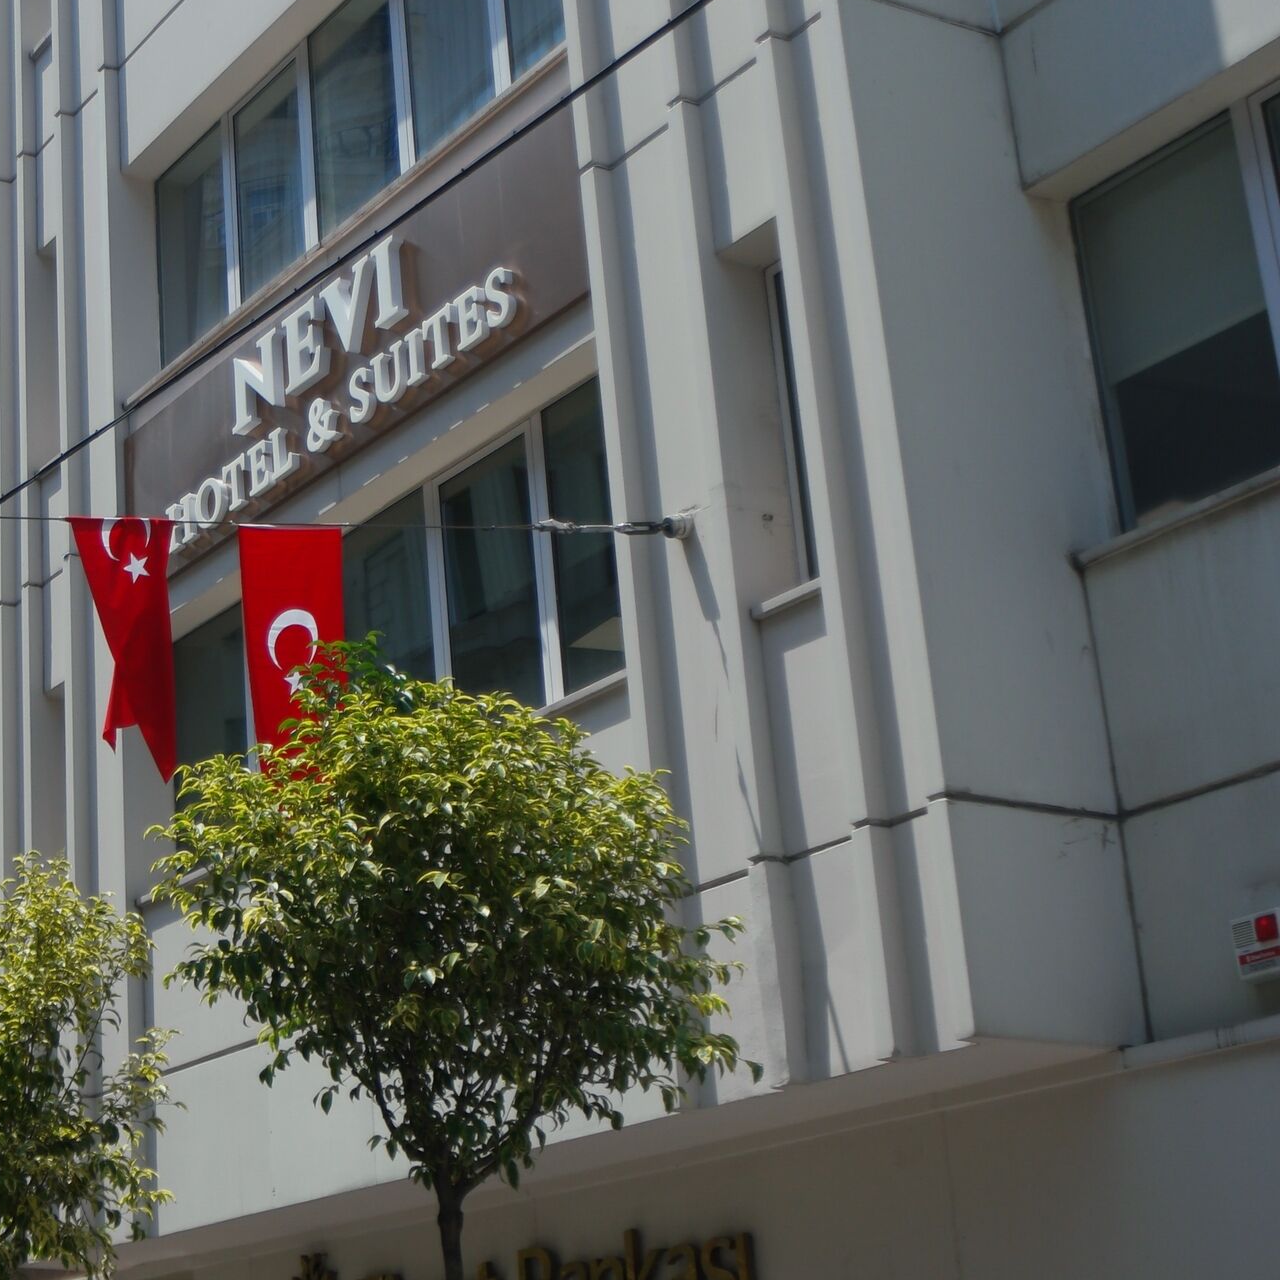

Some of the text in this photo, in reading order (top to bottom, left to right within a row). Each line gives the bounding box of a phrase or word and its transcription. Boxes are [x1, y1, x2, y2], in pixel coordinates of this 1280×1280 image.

[165, 266, 516, 554] HOTEL & SUITES
[231, 234, 409, 436] NEVI
